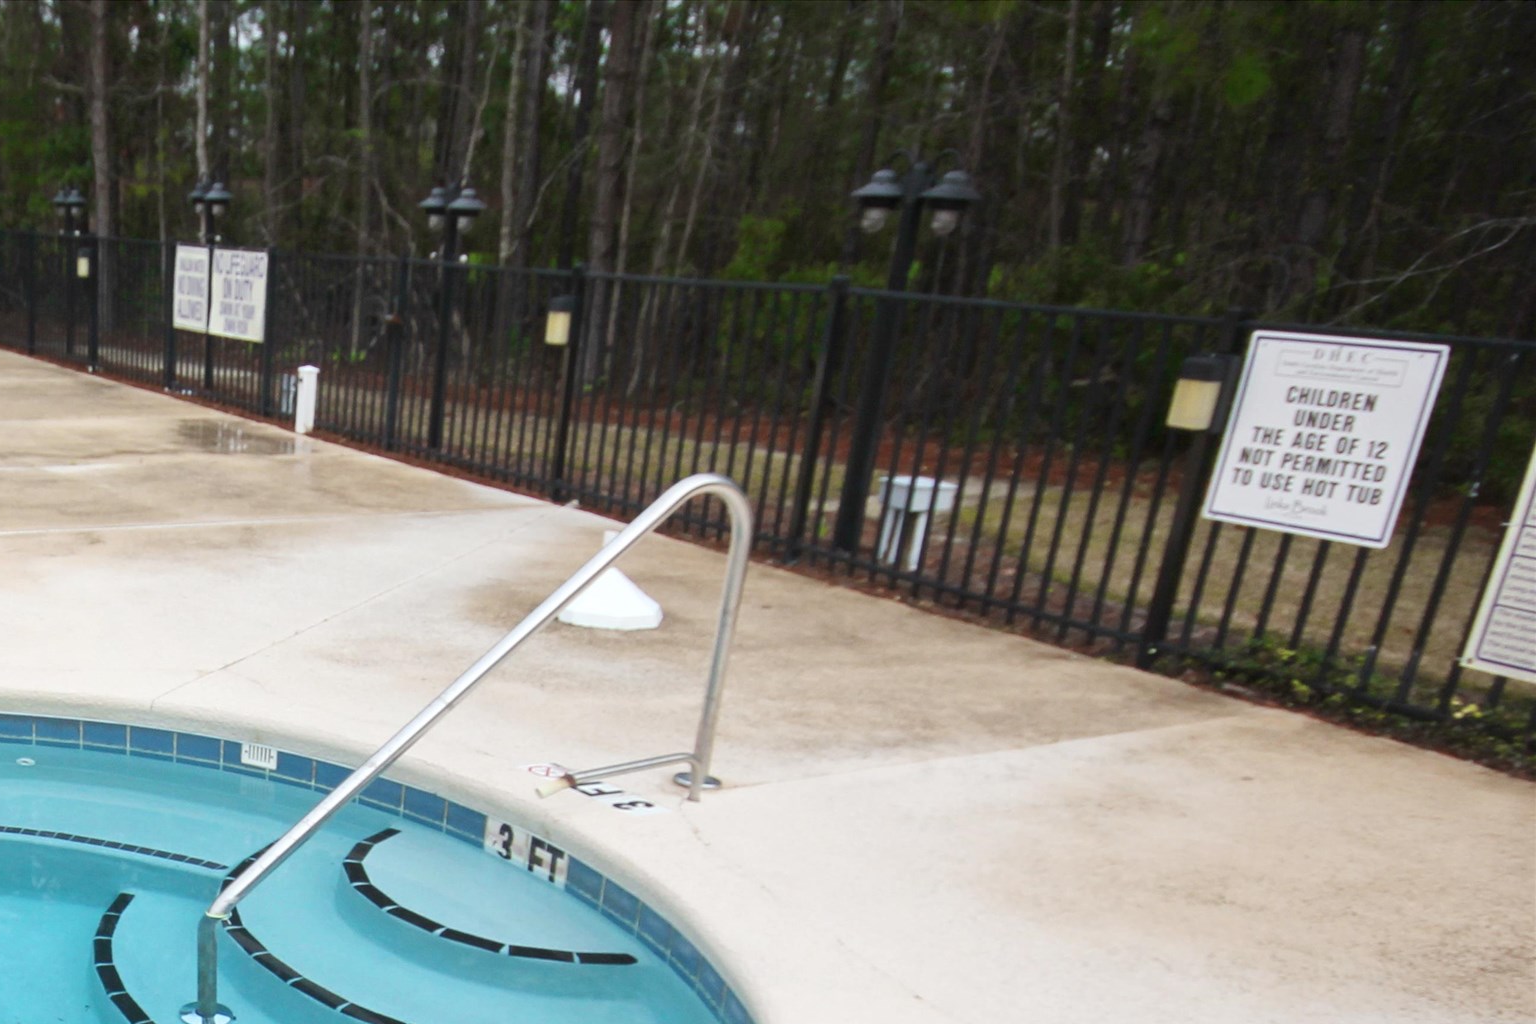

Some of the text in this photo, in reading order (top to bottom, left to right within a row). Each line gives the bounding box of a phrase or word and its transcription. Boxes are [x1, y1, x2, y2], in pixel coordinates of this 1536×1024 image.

[1285, 385, 1379, 412] CHILDREN
[1293, 409, 1357, 432] UNDER
[1252, 426, 1389, 460] THE AGE OF 12
[1239, 447, 1388, 483] NOT PERMITTED
[1232, 467, 1253, 486] TO
[1260, 472, 1296, 492] USE
[1301, 478, 1339, 499] HOT
[1346, 484, 1383, 506] TUB
[497, 822, 565, 884] 3 FT
